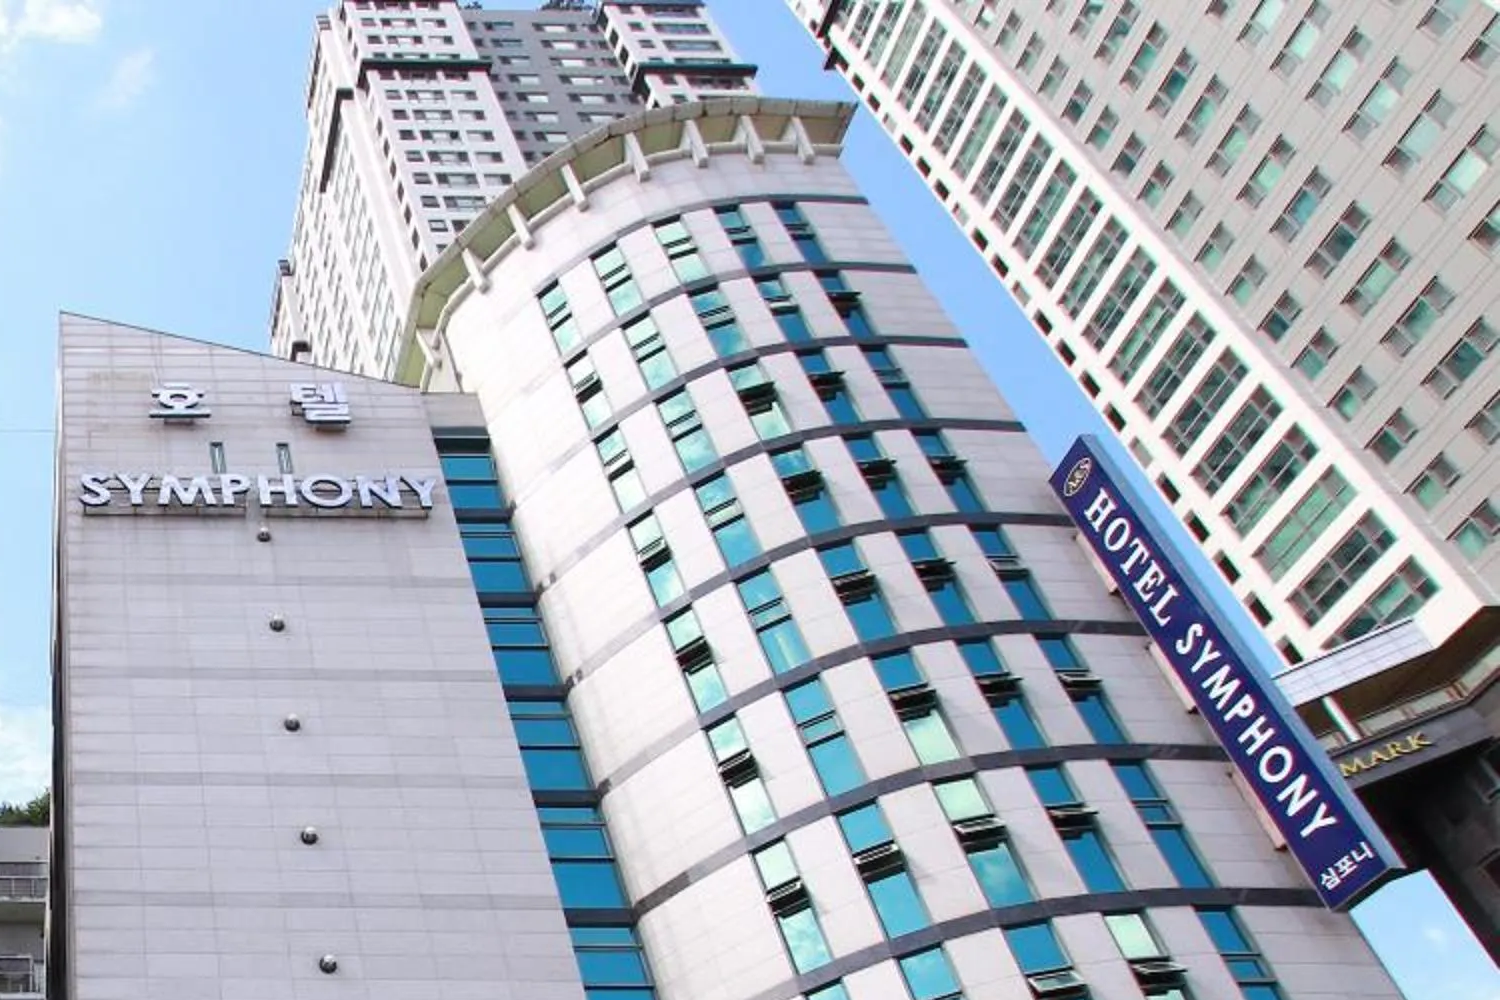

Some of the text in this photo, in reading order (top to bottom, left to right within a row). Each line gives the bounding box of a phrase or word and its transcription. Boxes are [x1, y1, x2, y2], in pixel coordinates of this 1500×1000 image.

[78, 473, 437, 510] SYMPHONY
[1084, 487, 1338, 838] HOTEL SYMPHONY
[1339, 731, 1433, 777] MARK
[1320, 841, 1375, 890] 심포니
